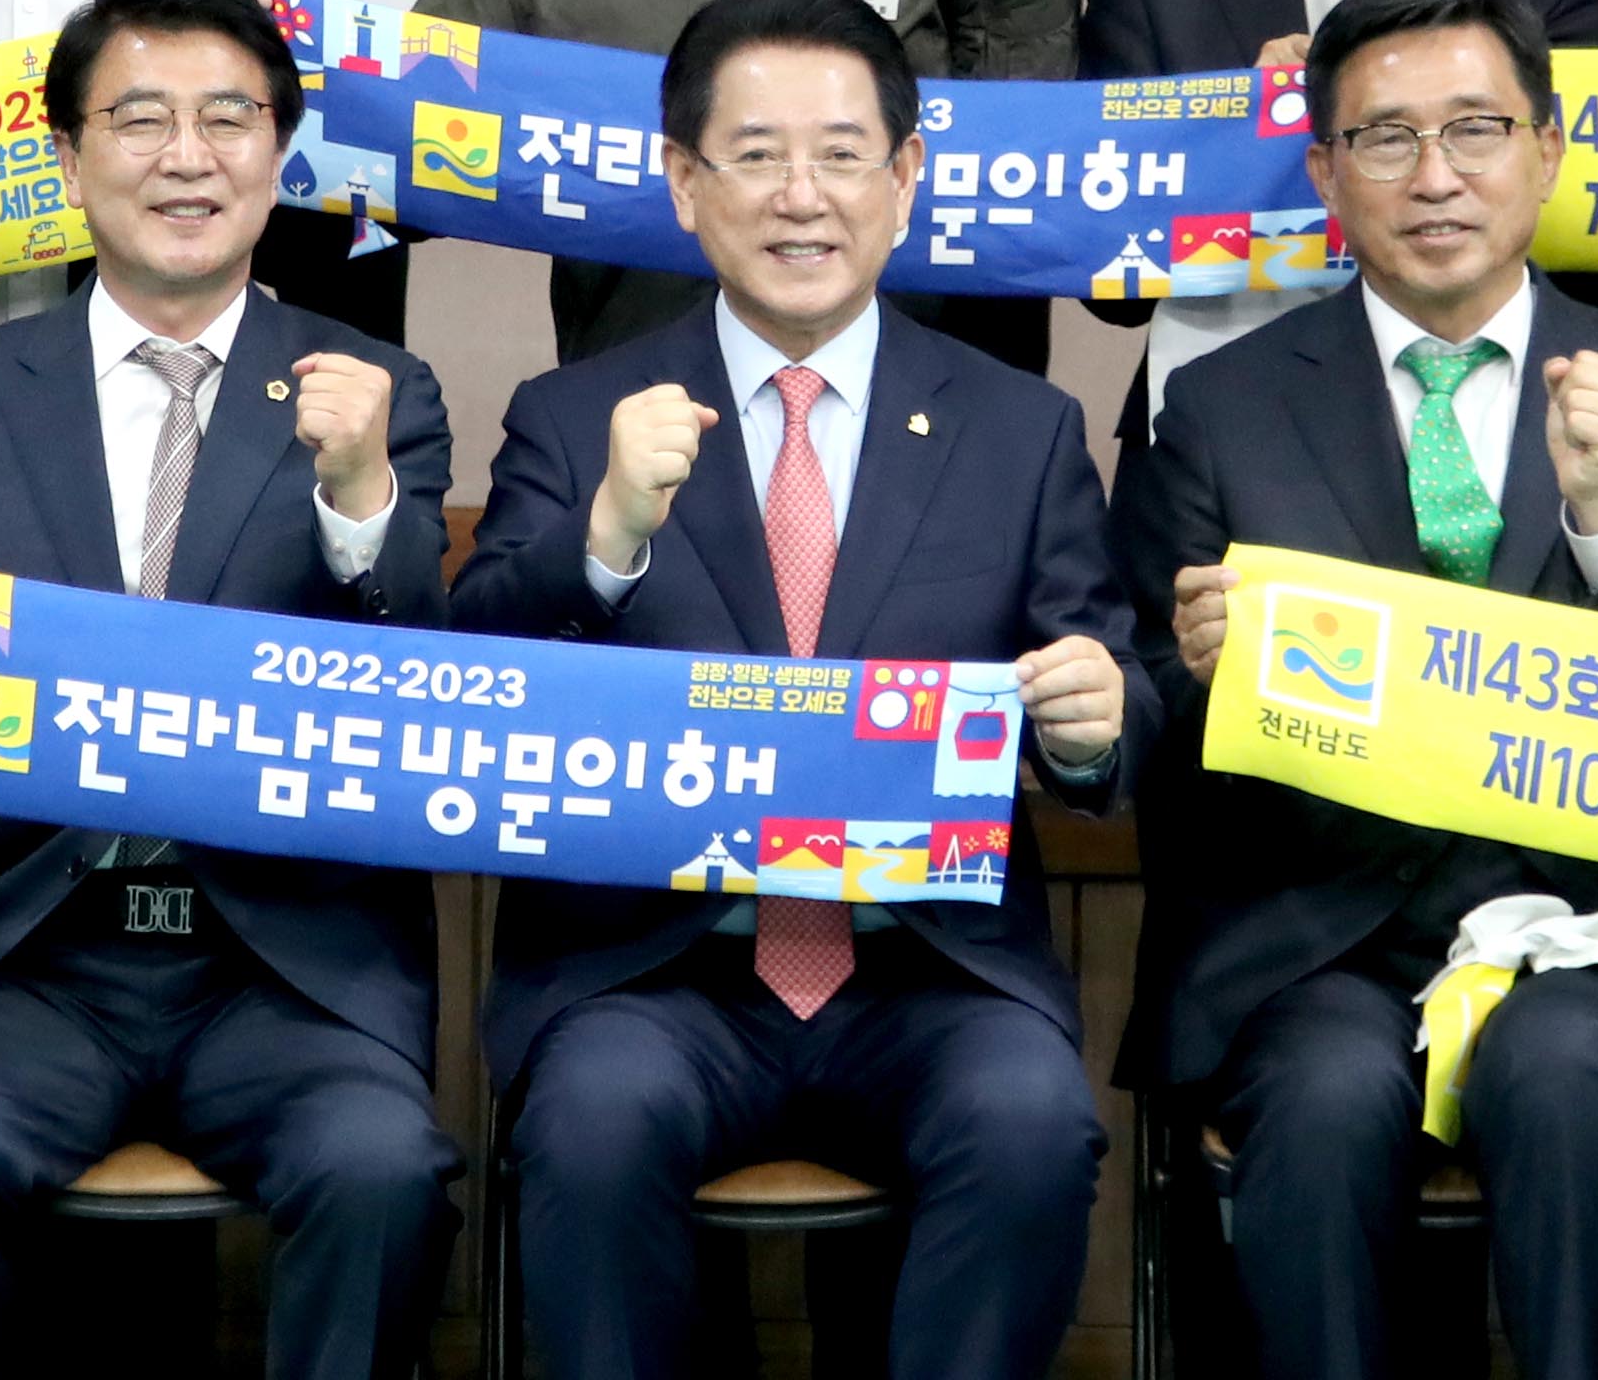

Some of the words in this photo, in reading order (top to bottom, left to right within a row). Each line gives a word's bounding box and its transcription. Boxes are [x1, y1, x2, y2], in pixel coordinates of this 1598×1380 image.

[1102, 98, 1183, 121] 전남으로
[1187, 96, 1251, 119] 오세요
[252, 642, 526, 708] 2022-2023
[688, 684, 775, 712] 전남으로
[779, 689, 847, 715] 오세요
[53, 677, 384, 819] 전라남도
[1258, 707, 1369, 759] 전라남도
